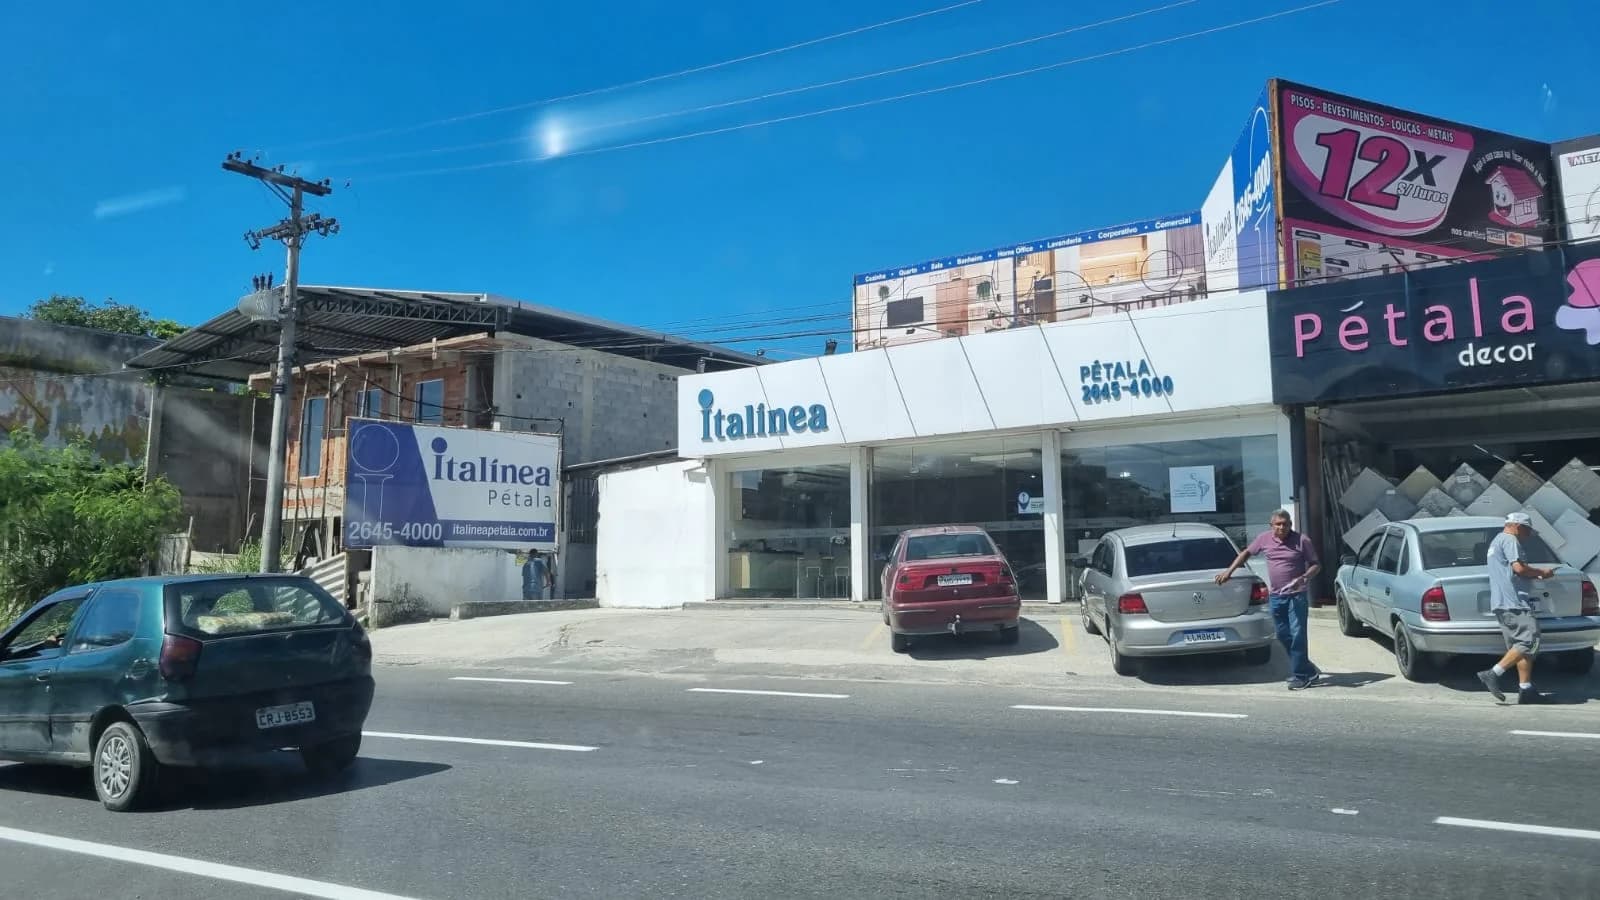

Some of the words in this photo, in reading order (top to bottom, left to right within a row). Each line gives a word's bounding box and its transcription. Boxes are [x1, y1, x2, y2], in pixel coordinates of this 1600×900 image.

[1291, 94, 1315, 110] PISOS
[1322, 102, 1384, 127] REVESTIMENTOS
[1391, 119, 1421, 137] LOUÇAS
[1427, 128, 1454, 143] METAIS
[1015, 245, 1034, 254] Office
[1047, 236, 1082, 249] Lavanderia
[1098, 227, 1138, 240] Corporativo
[1155, 216, 1192, 229] Comercial
[1293, 277, 1534, 357] Pétala
[1458, 341, 1536, 366] decor
[1080, 359, 1151, 383] PÉTALA
[488, 487, 551, 508] Pétala
[349, 521, 442, 541] 2645-4000
